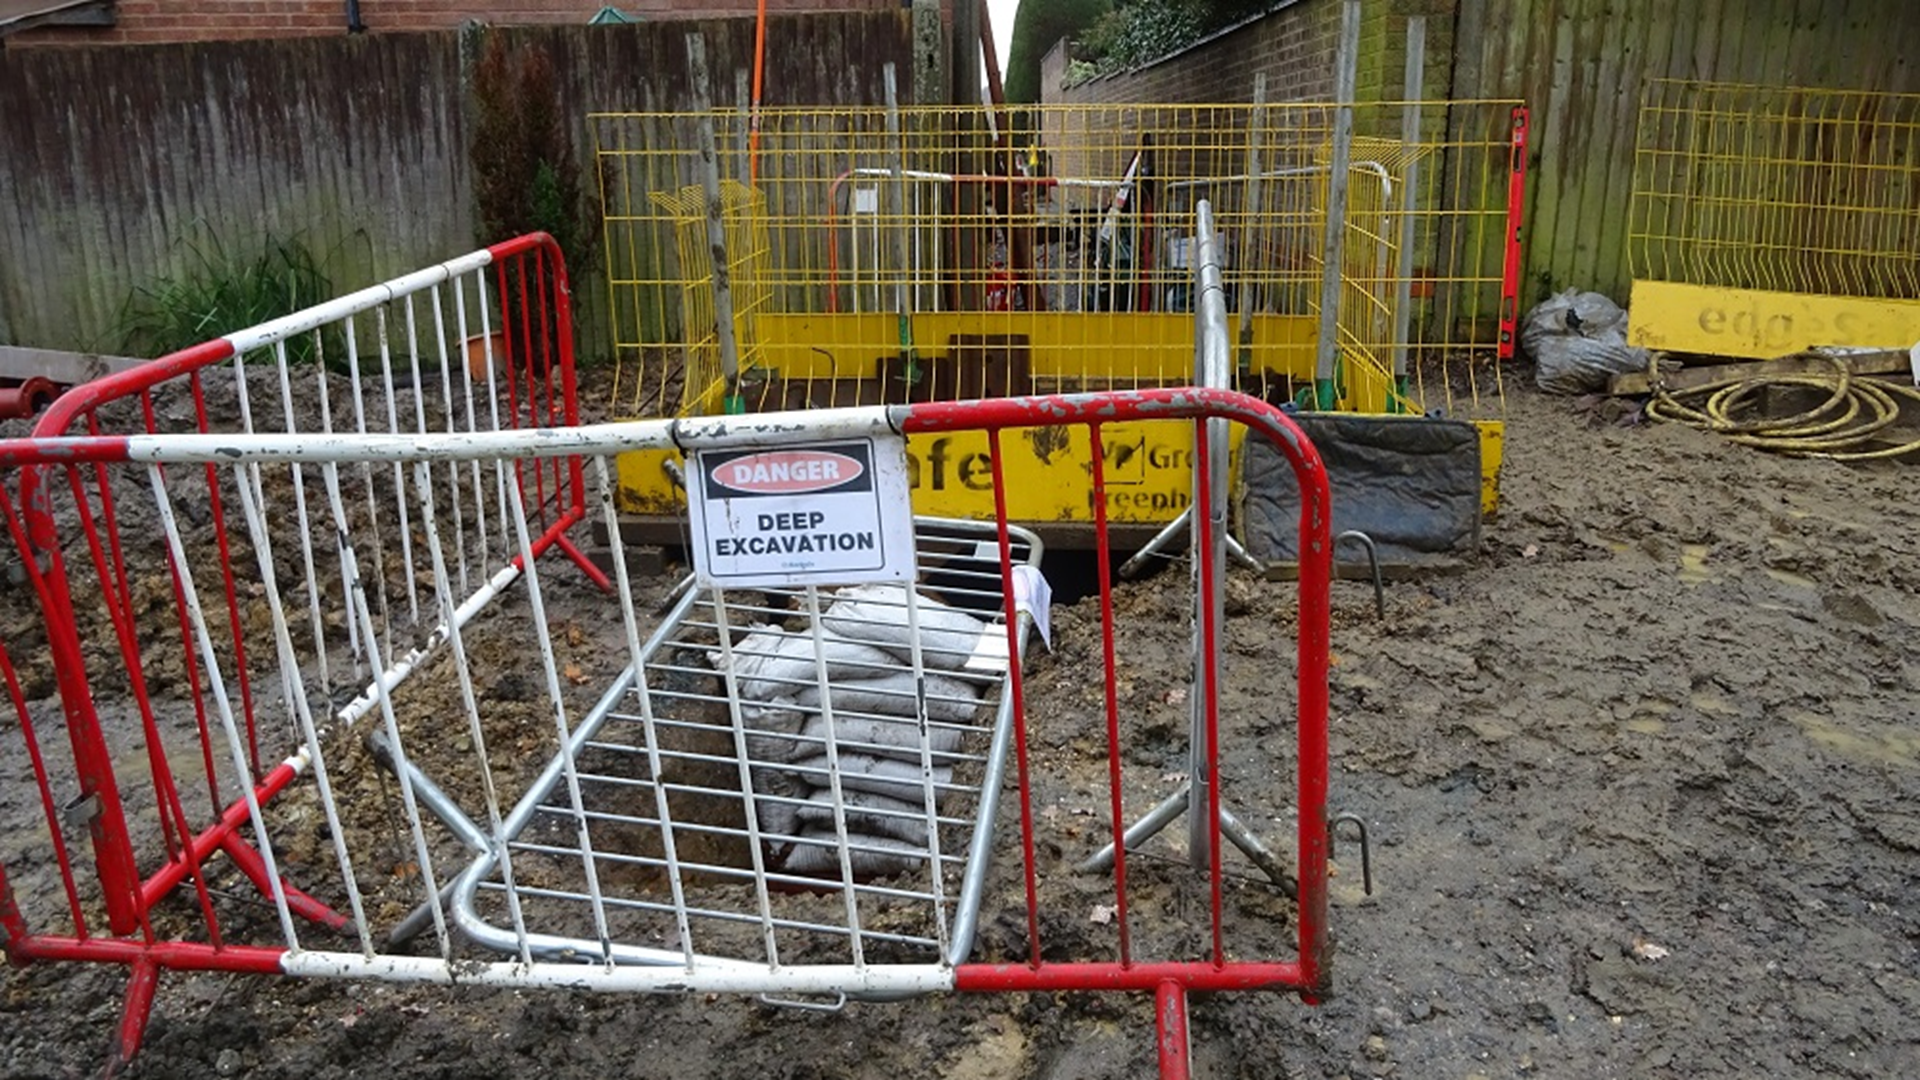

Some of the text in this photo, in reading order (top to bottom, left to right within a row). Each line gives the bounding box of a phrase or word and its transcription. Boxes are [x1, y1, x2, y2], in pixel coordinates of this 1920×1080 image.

[733, 460, 840, 485] DANGER
[758, 511, 825, 532] DEEP
[715, 532, 874, 556] EXCAVATION
